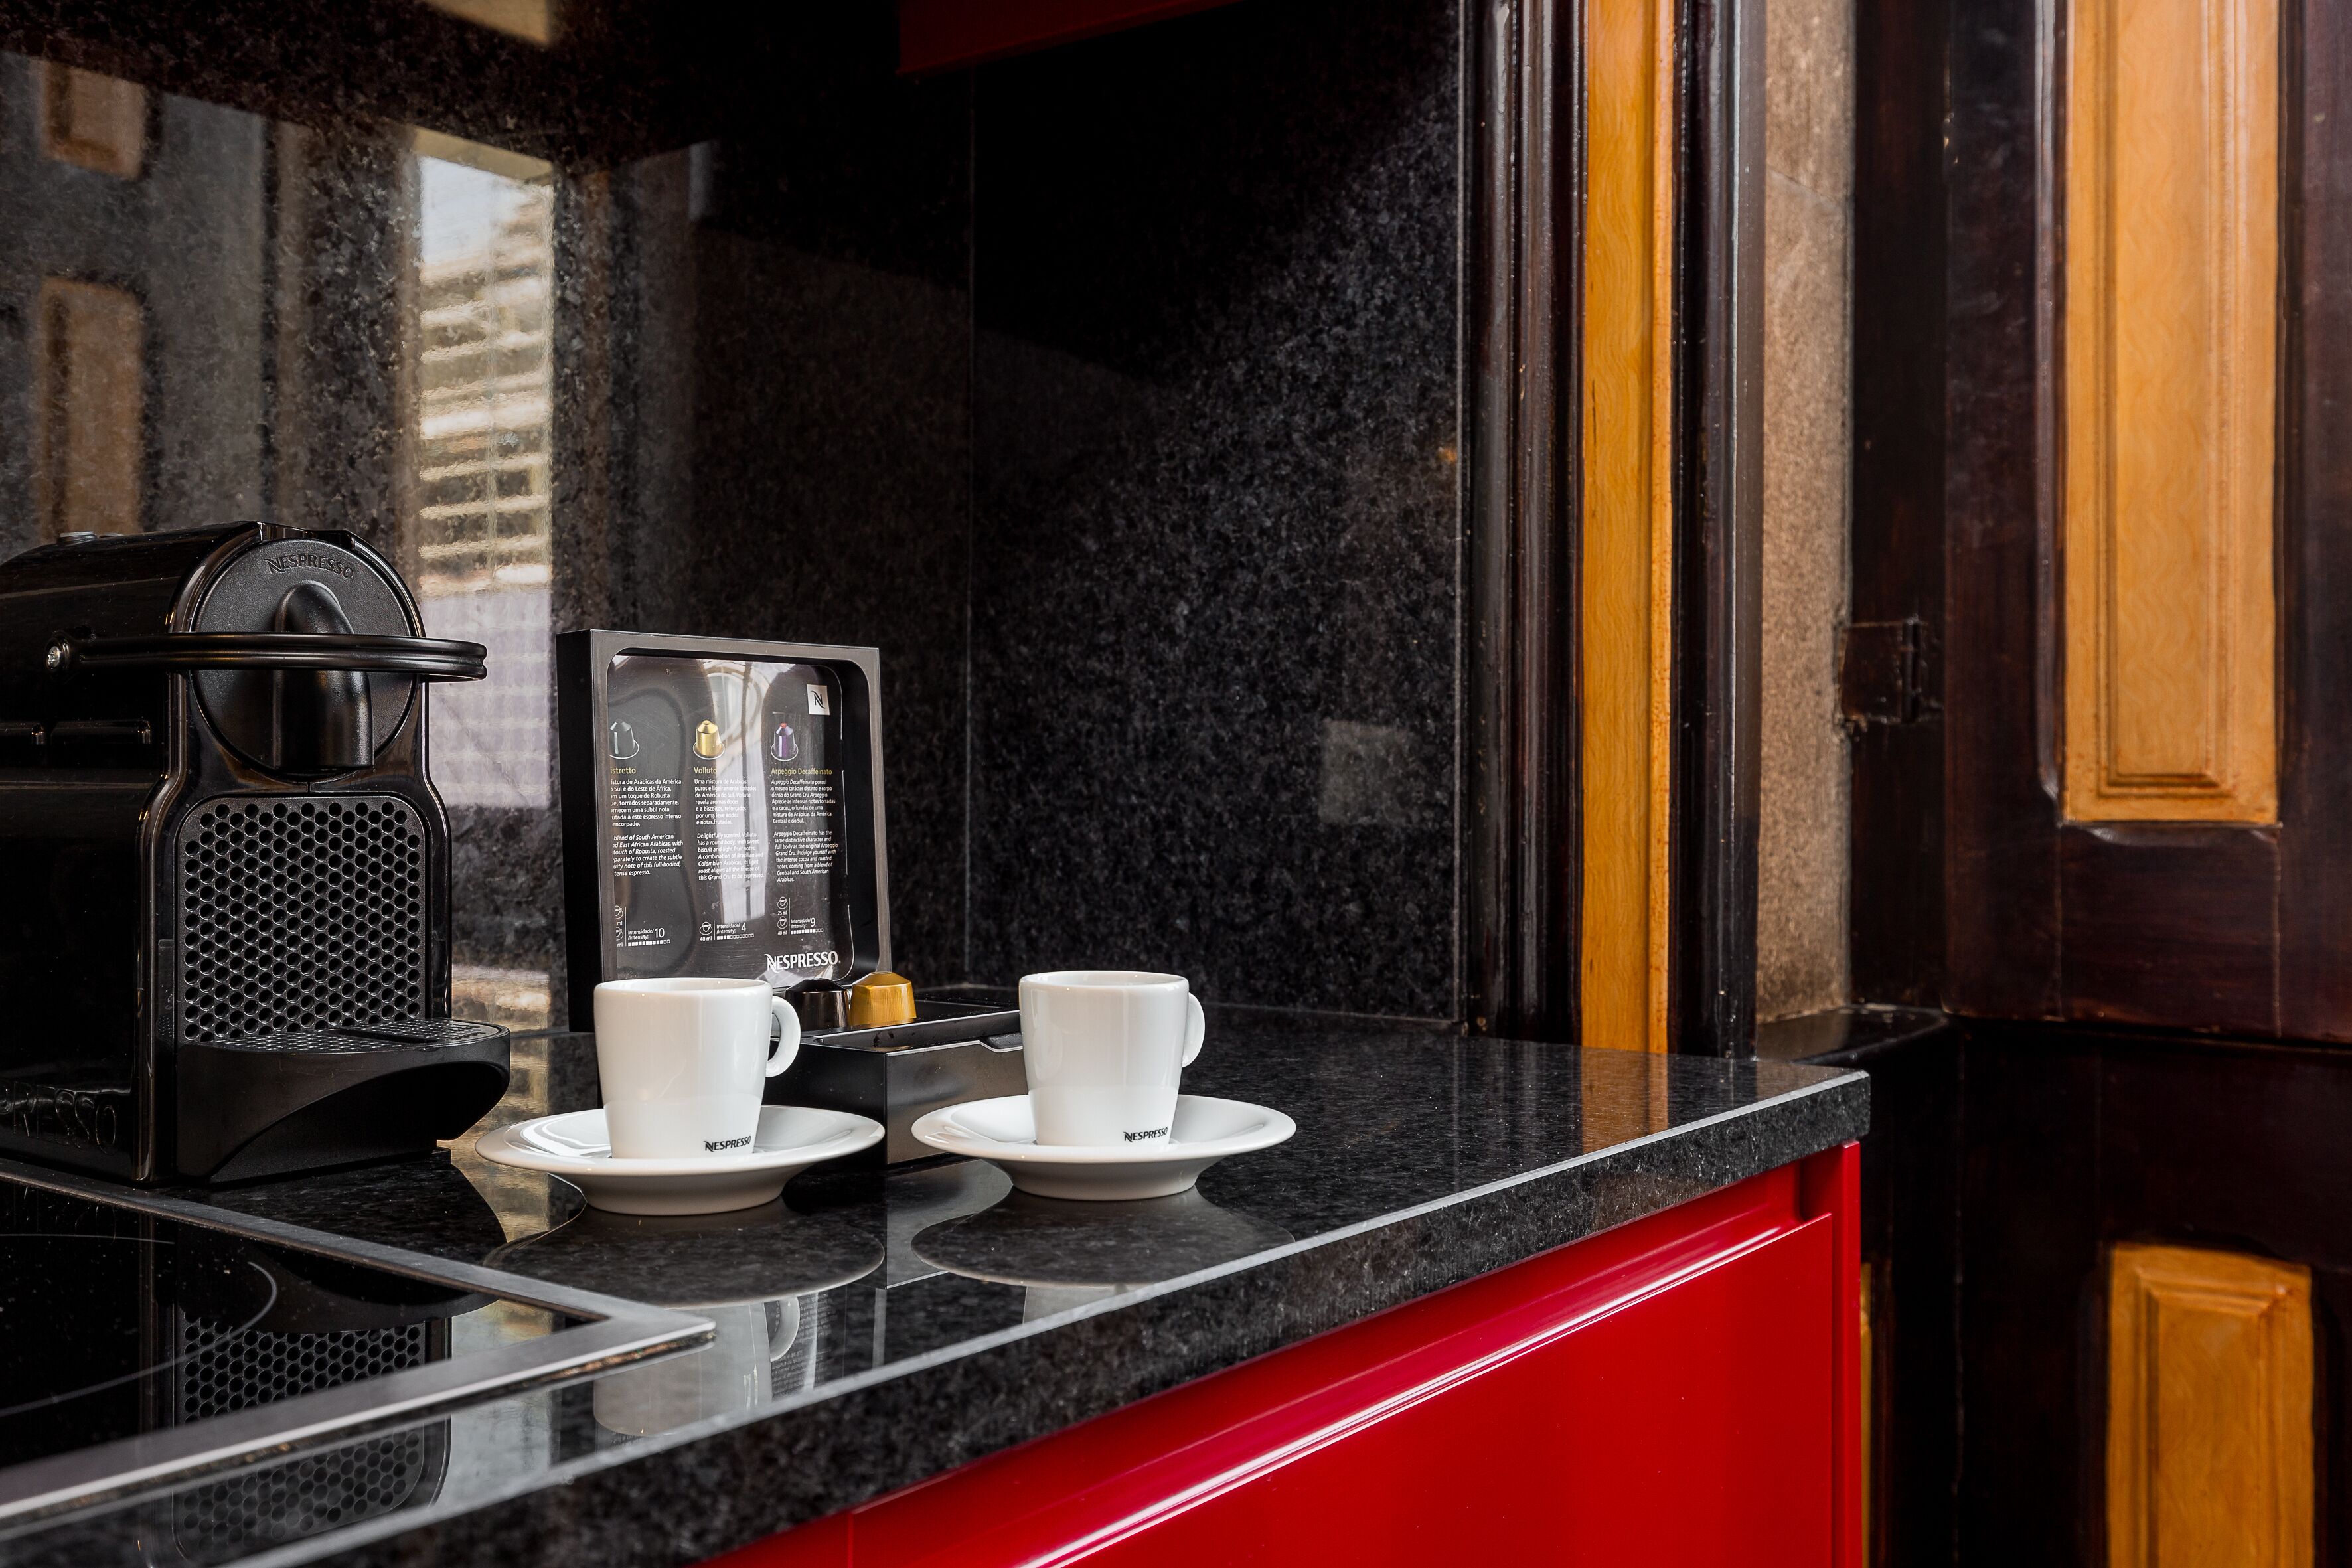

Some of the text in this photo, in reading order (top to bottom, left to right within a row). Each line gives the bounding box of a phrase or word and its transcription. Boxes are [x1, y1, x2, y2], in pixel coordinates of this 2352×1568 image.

[264, 554, 354, 578] NESPRESSO
[741, 922, 746, 932] 4
[811, 918, 815, 927] 9
[655, 928, 665, 938] 10
[764, 951, 838, 973] NESPRESSO
[1123, 1127, 1168, 1142] NESPRESSO
[703, 1136, 751, 1152] NESPRESSO
